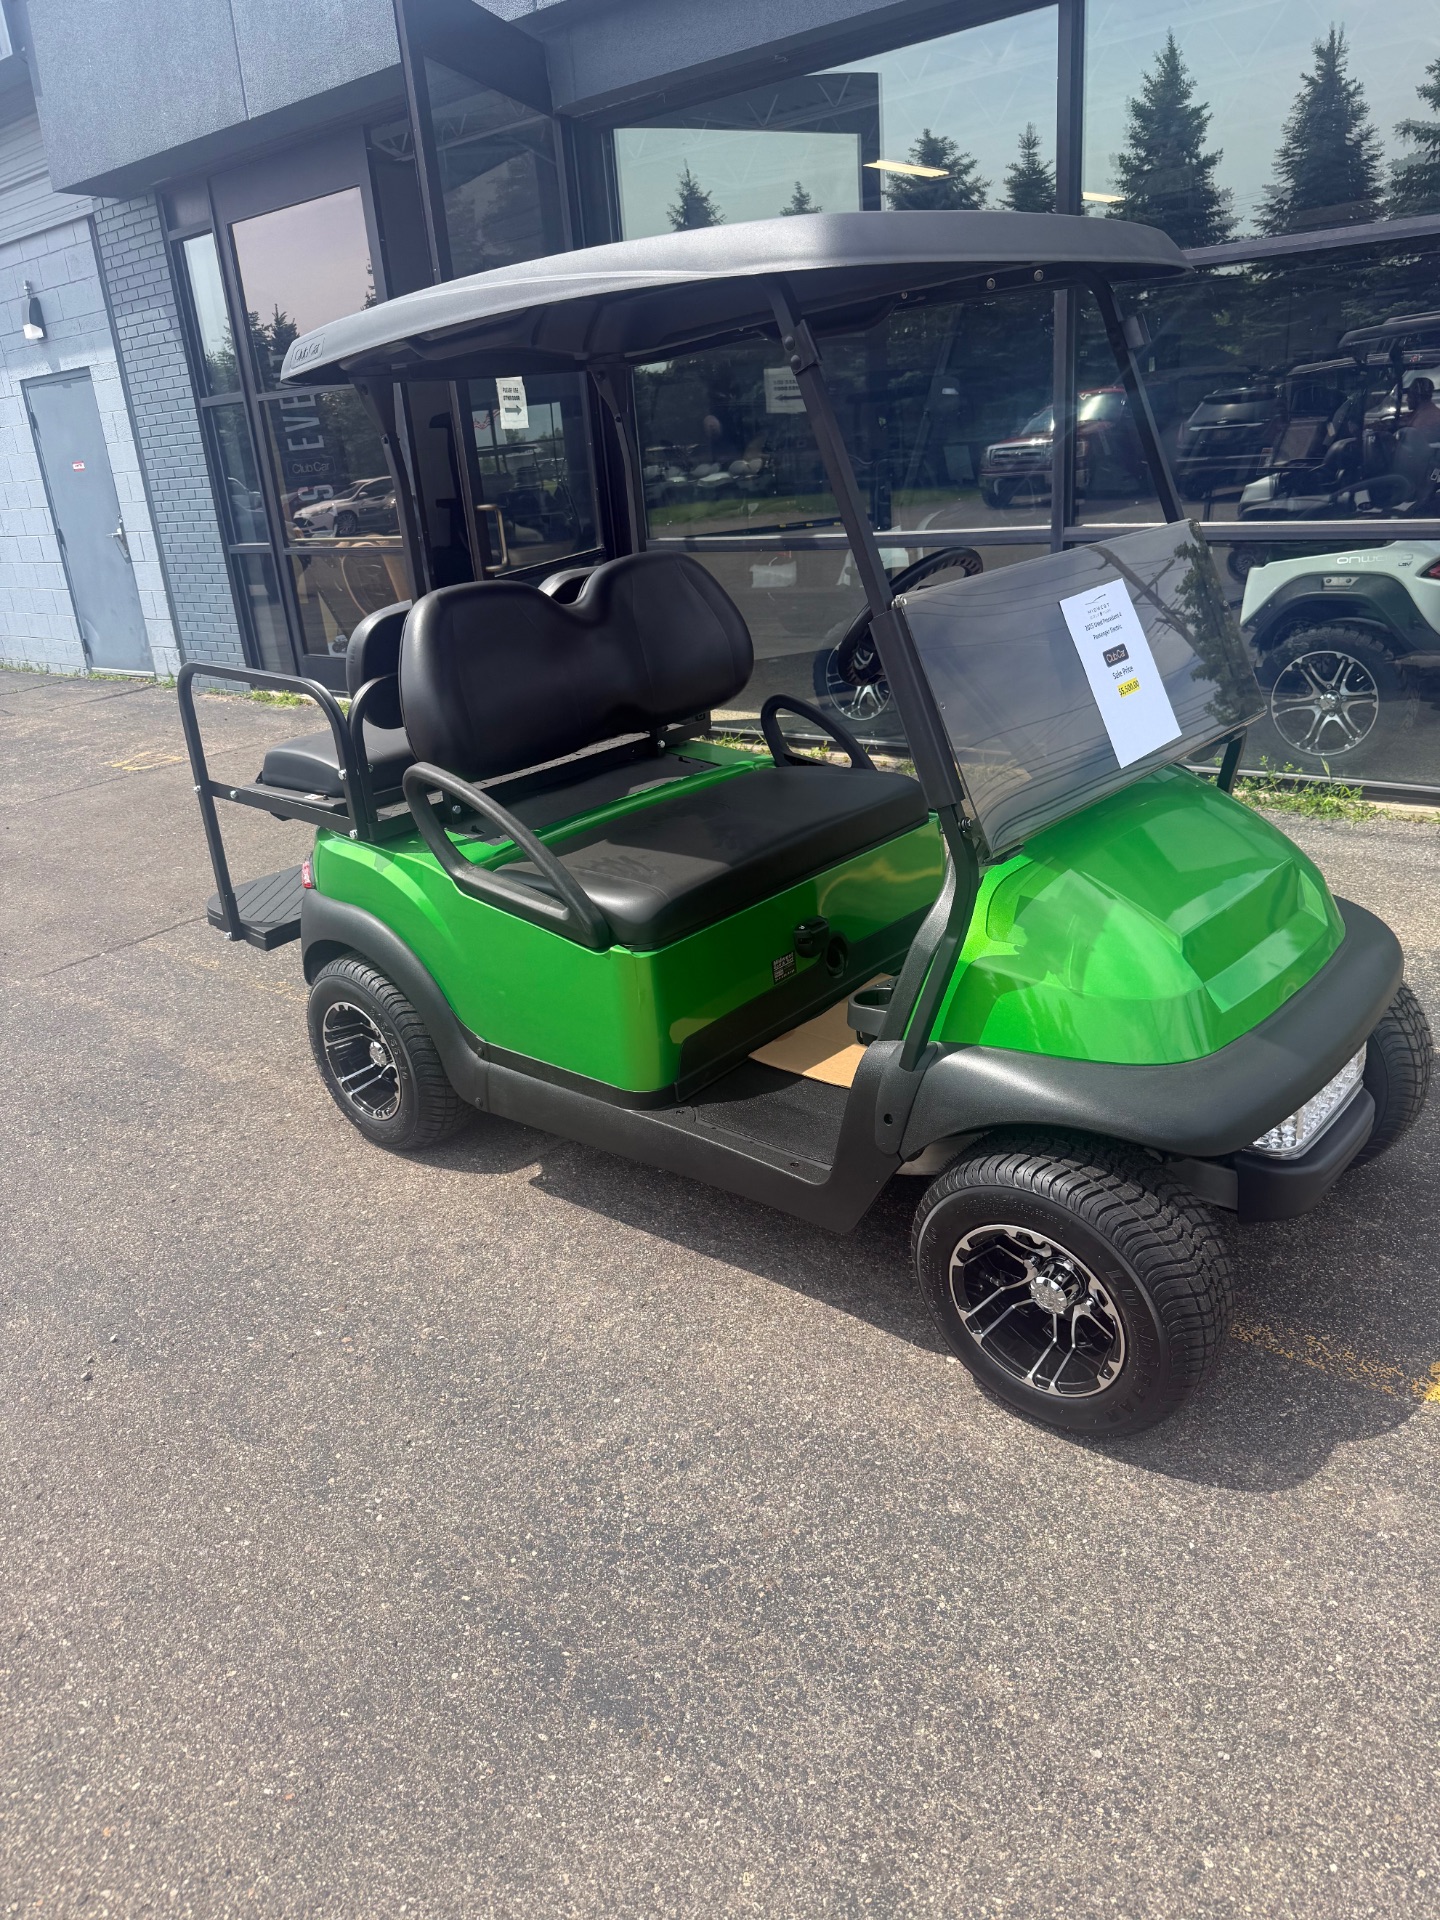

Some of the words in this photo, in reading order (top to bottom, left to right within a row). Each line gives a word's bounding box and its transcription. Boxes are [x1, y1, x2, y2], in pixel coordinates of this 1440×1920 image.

[292, 462, 313, 474] Club
[313, 461, 330, 473] Car
[1112, 670, 1122, 679] Sale
[1122, 666, 1134, 675] Price
